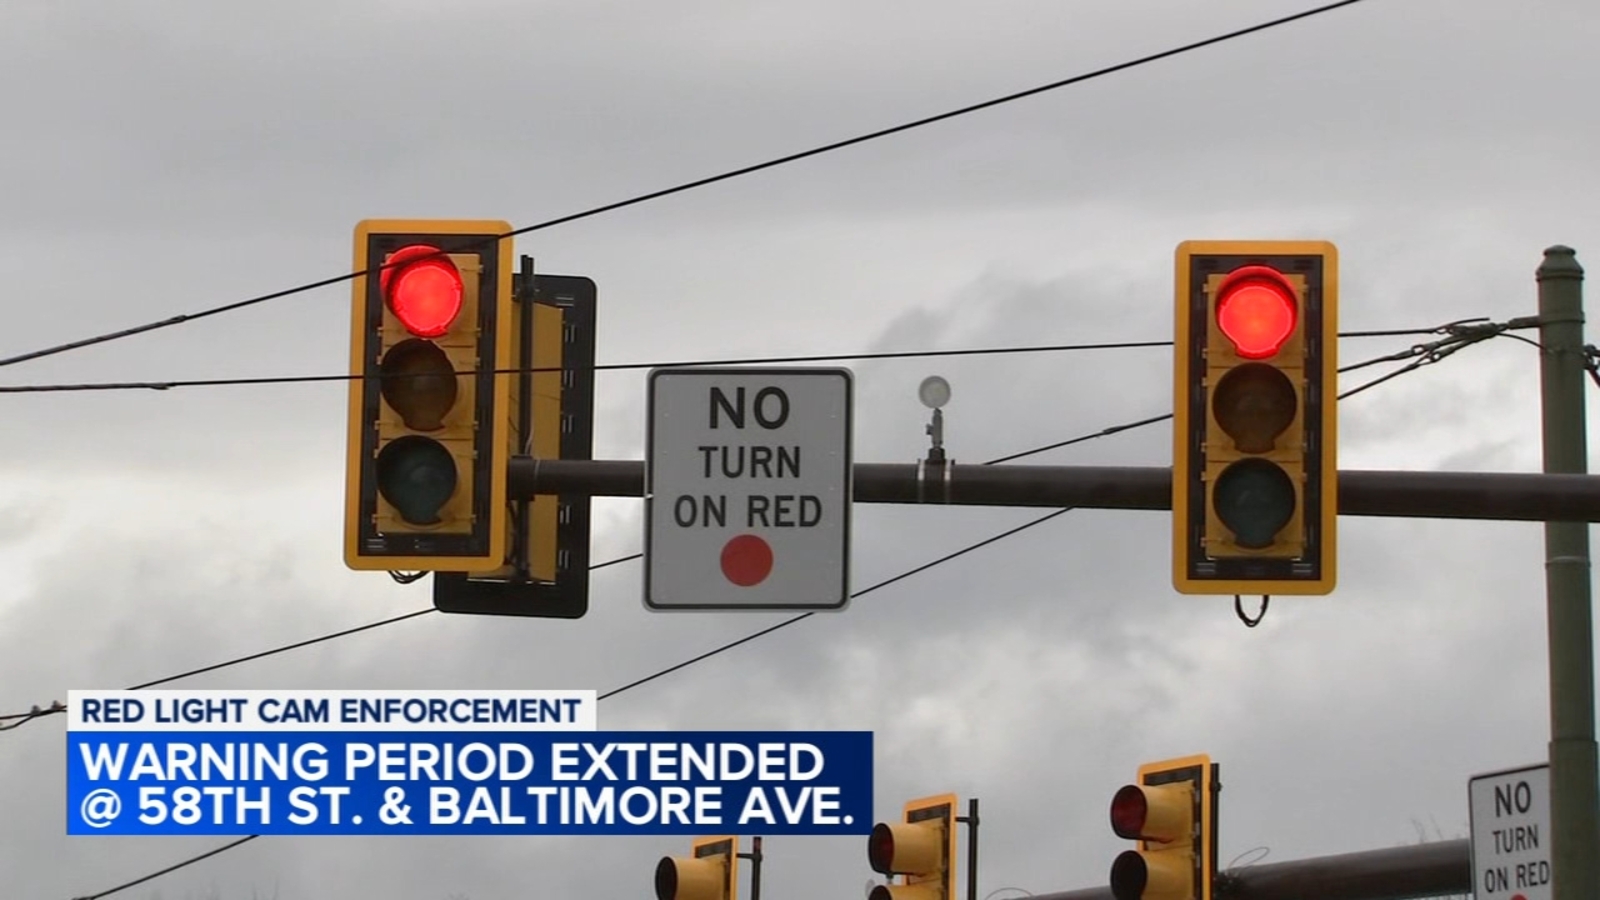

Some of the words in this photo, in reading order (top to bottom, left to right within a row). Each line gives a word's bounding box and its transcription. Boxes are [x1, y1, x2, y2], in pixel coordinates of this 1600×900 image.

[709, 386, 790, 430] NO
[698, 446, 800, 478] TURN
[674, 495, 726, 527] ON
[747, 495, 822, 527] RED
[1495, 781, 1531, 818] NO
[1492, 824, 1539, 854] TURN
[1485, 866, 1509, 893] ON
[1516, 860, 1549, 889] RED
